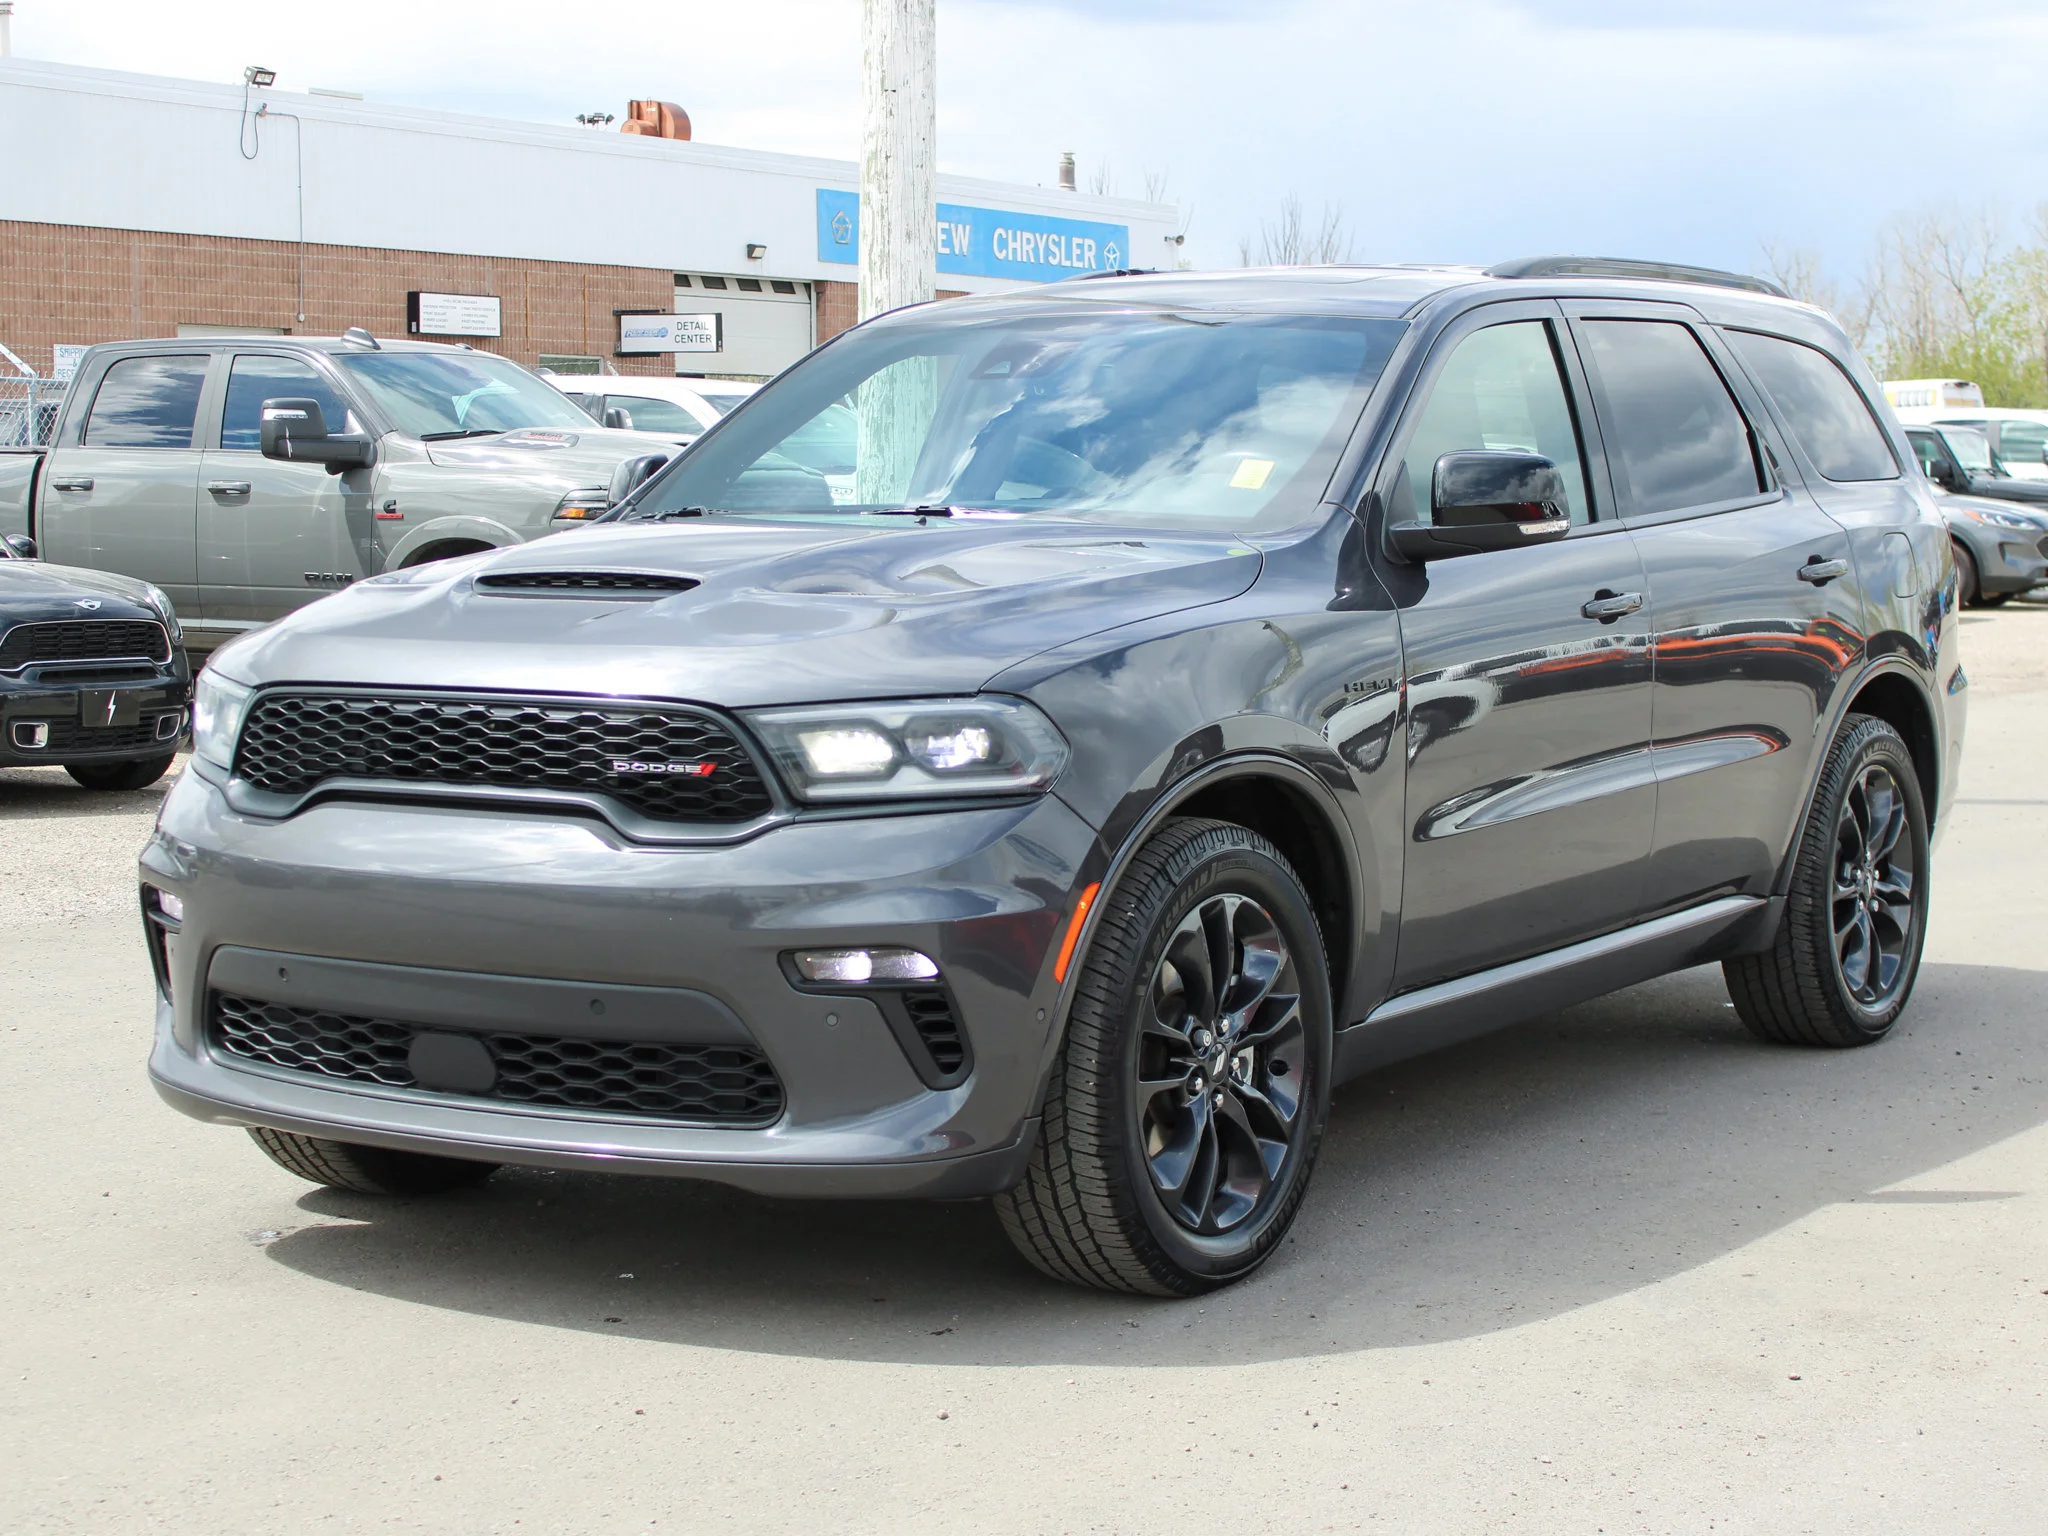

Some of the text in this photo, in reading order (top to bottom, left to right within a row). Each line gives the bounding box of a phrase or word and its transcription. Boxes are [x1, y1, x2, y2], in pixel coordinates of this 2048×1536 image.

[936, 221, 1097, 270] EW CHRYSLER
[676, 321, 709, 332] DETAIL
[674, 333, 713, 344] CENTER
[612, 760, 703, 774] DODGE
[1152, 868, 1210, 958] MICHELIN
